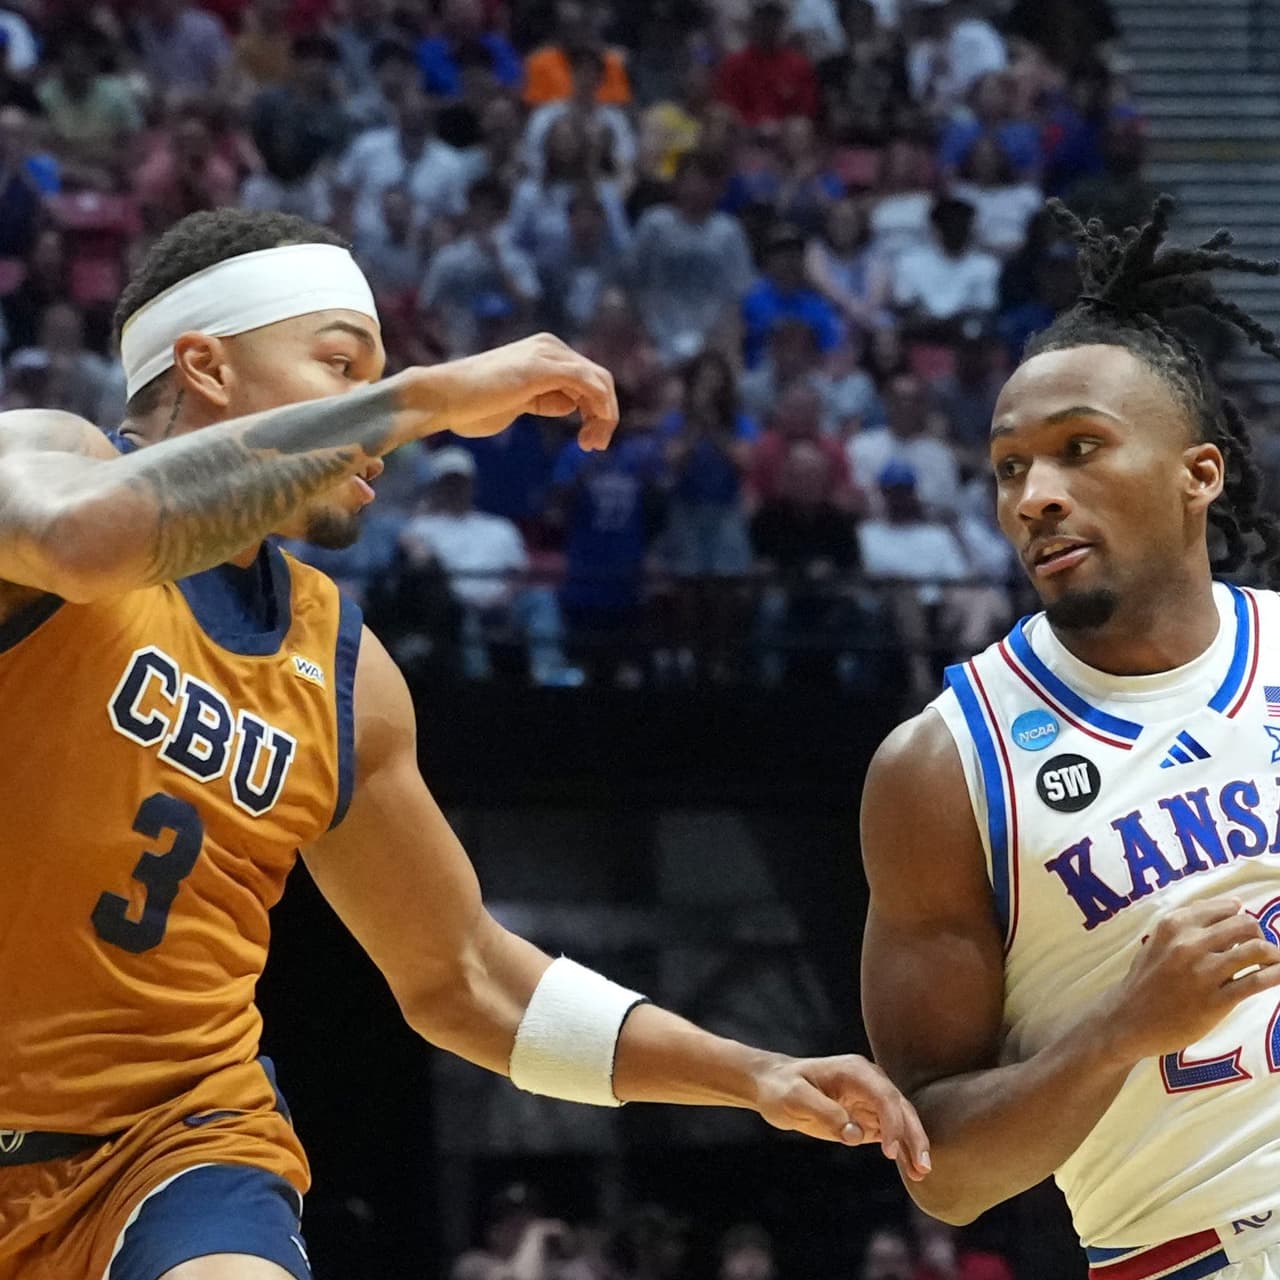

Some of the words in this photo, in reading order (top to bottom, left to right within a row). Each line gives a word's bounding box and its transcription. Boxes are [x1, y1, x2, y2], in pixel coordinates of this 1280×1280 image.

[295, 657, 324, 681] WA
[108, 645, 297, 816] CBU
[1018, 723, 1056, 743] NCAA
[1043, 762, 1092, 802] SW
[90, 791, 204, 955] 3
